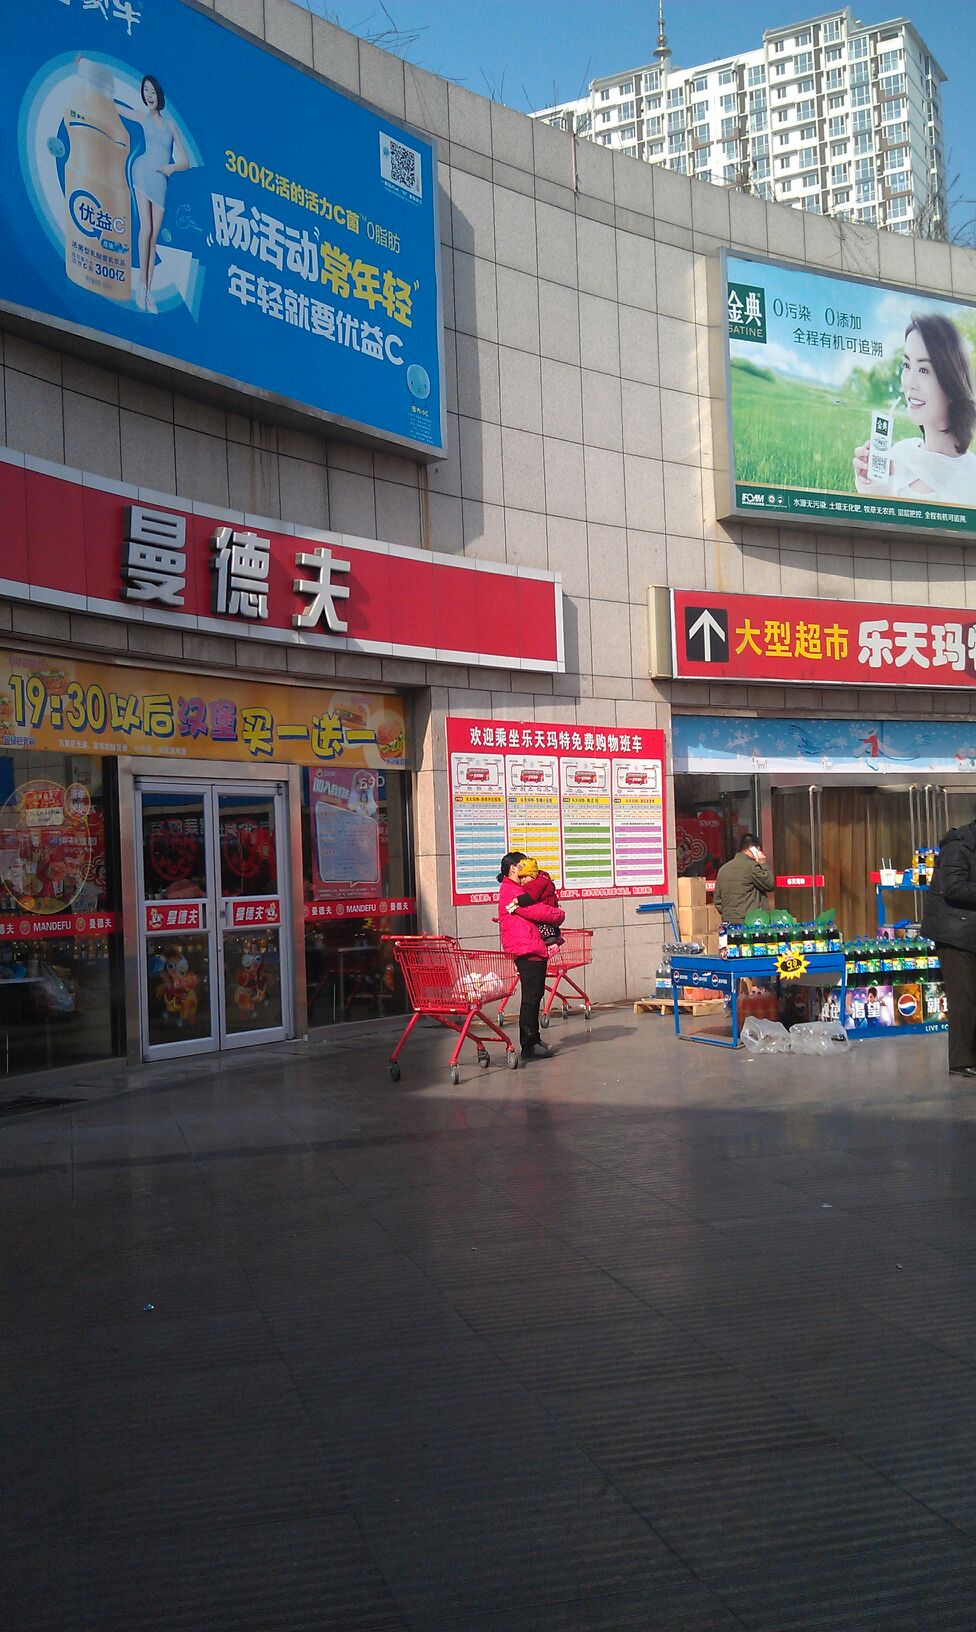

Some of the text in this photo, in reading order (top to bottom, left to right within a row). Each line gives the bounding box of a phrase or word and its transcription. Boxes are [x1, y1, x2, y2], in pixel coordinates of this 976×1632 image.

[228, 264, 404, 365] 年轻就要优益C
[728, 289, 763, 327] 金典
[773, 298, 862, 330] 0污染 0添加
[793, 327, 883, 357] 全程有机可追溯
[121, 504, 351, 633] 曼德夫
[735, 618, 976, 671] 大型超市 乐天玛
[469, 727, 643, 753] 欢迎乘坐乐天玛特免费购物班车
[166, 909, 198, 925] 曼德夫
[235, 905, 264, 922] 曼德夫
[346, 904, 377, 913] MANDEFU
[33, 921, 72, 932] MANDEFU
